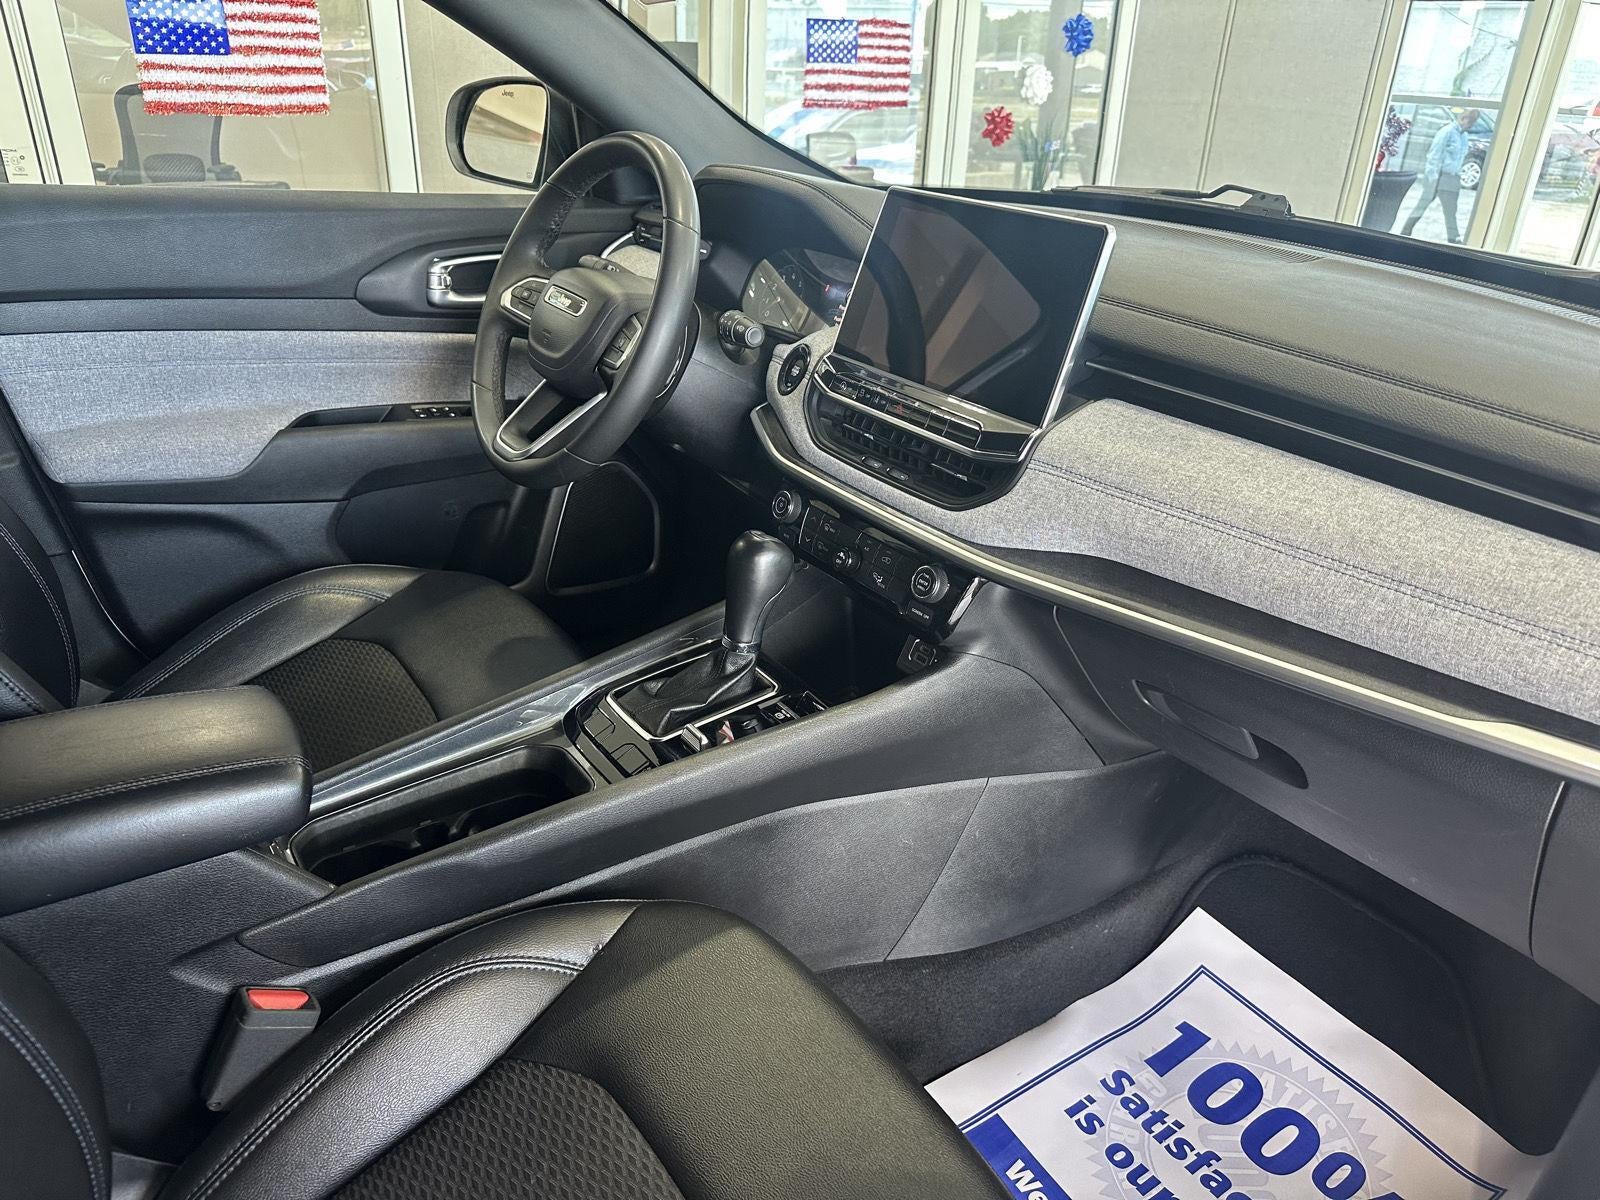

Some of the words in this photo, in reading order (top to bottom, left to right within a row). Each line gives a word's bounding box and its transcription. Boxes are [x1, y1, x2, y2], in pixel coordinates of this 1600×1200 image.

[501, 89, 514, 98] Jeep
[1064, 1094, 1105, 1135] is
[1100, 1069, 1253, 1200] Satisfa
